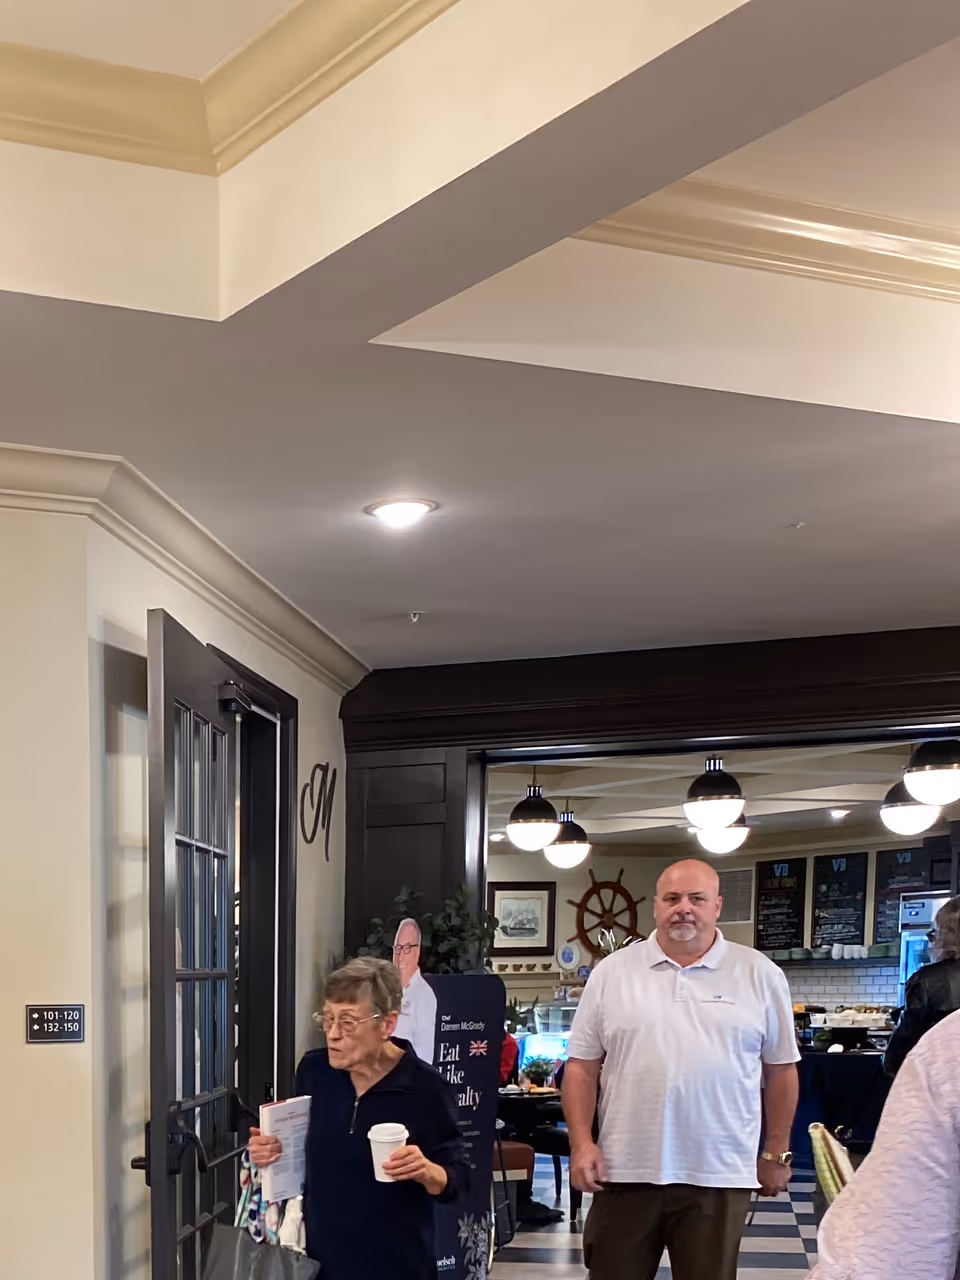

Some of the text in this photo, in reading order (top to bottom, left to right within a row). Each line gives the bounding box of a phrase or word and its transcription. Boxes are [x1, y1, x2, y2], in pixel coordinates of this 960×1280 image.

[43, 1010, 80, 1020] 101-120
[43, 1022, 80, 1032] 132-150
[441, 1021, 486, 1032] Darren McGrady
[439, 1042, 460, 1062] Eat
[457, 1086, 482, 1111] alty
